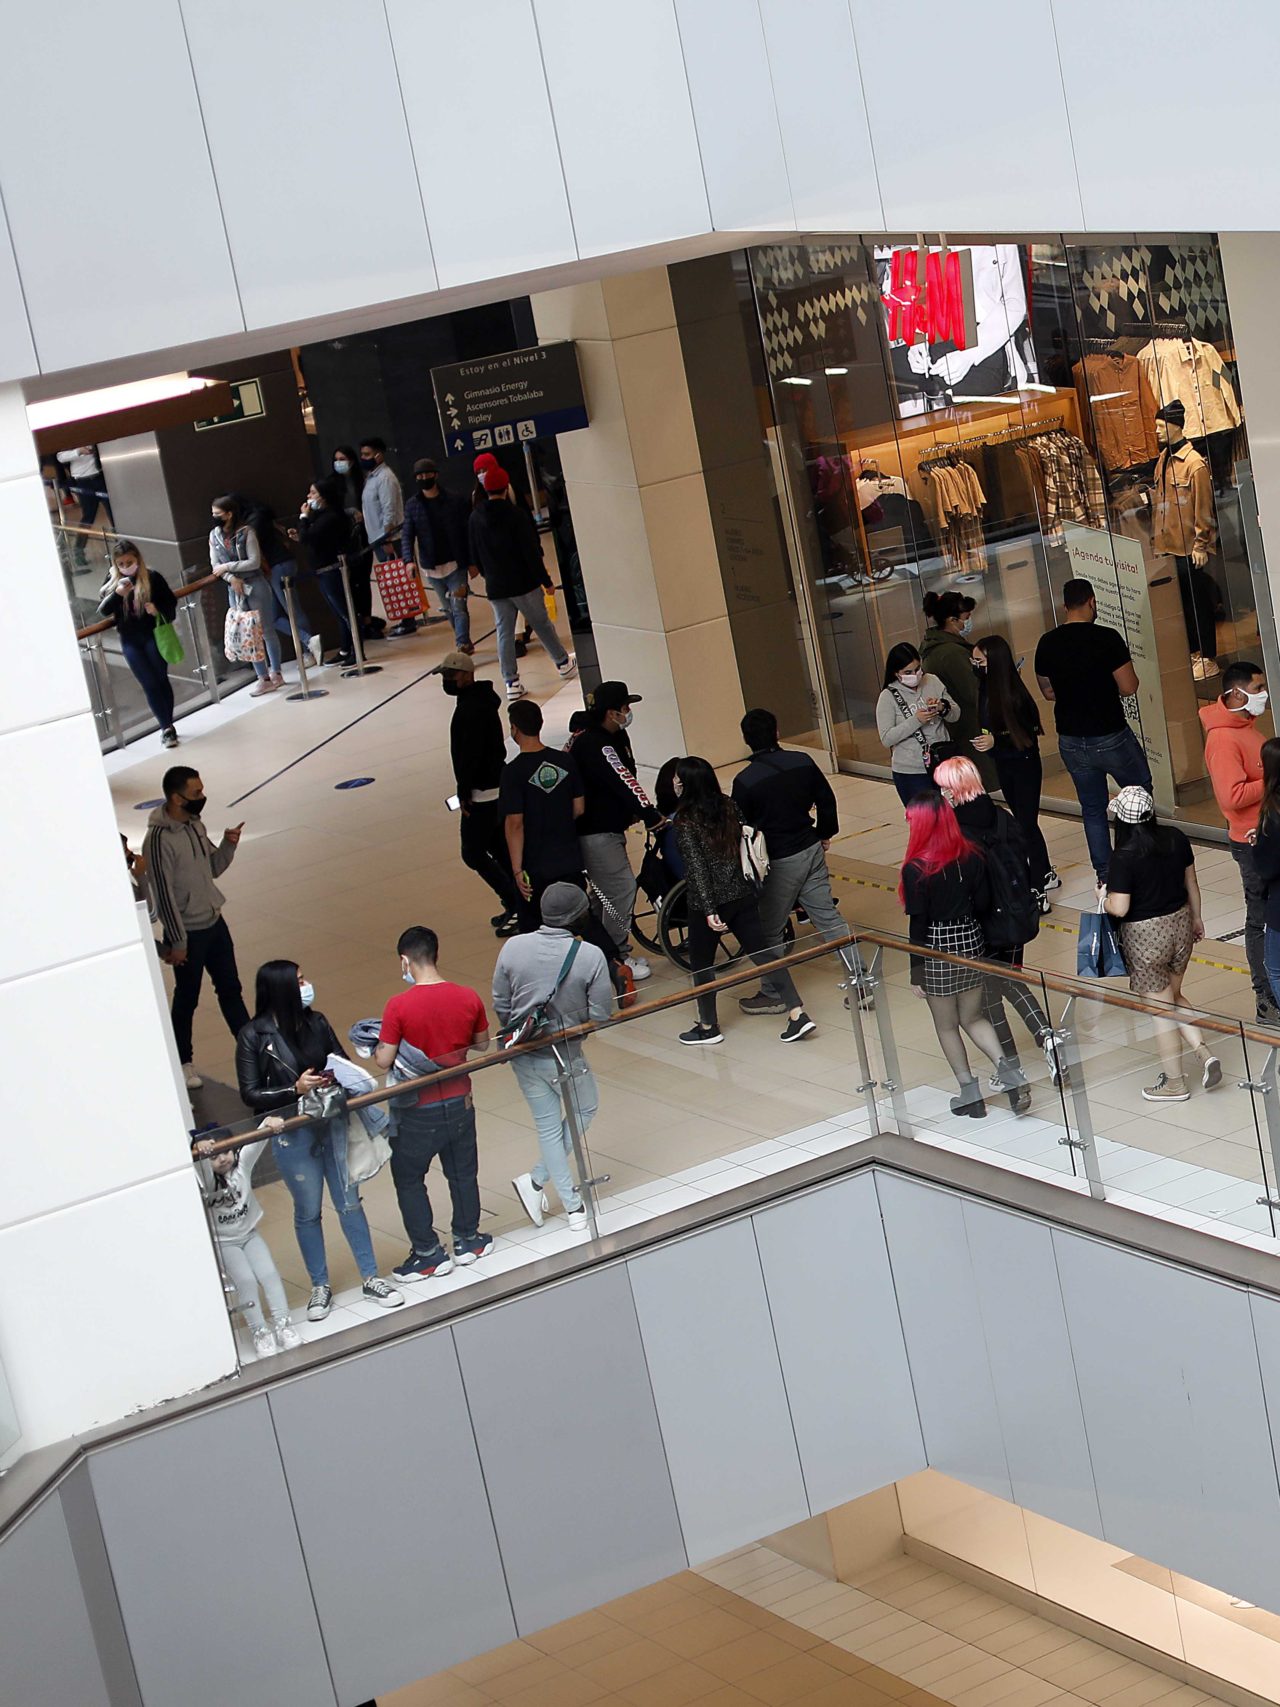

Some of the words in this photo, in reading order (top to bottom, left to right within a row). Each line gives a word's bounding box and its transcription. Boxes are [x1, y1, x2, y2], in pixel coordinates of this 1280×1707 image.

[880, 249, 967, 352] H&M
[459, 362, 485, 376] Estoy
[487, 361, 500, 371] en
[502, 356, 511, 368] el
[513, 352, 539, 366] Nivel
[540, 351, 547, 360] 3
[463, 386, 501, 400] Gimnasio
[501, 379, 529, 393] Energy
[466, 397, 509, 413] Ascensores
[509, 389, 544, 403] Tobalaba
[468, 412, 492, 425] Ripley
